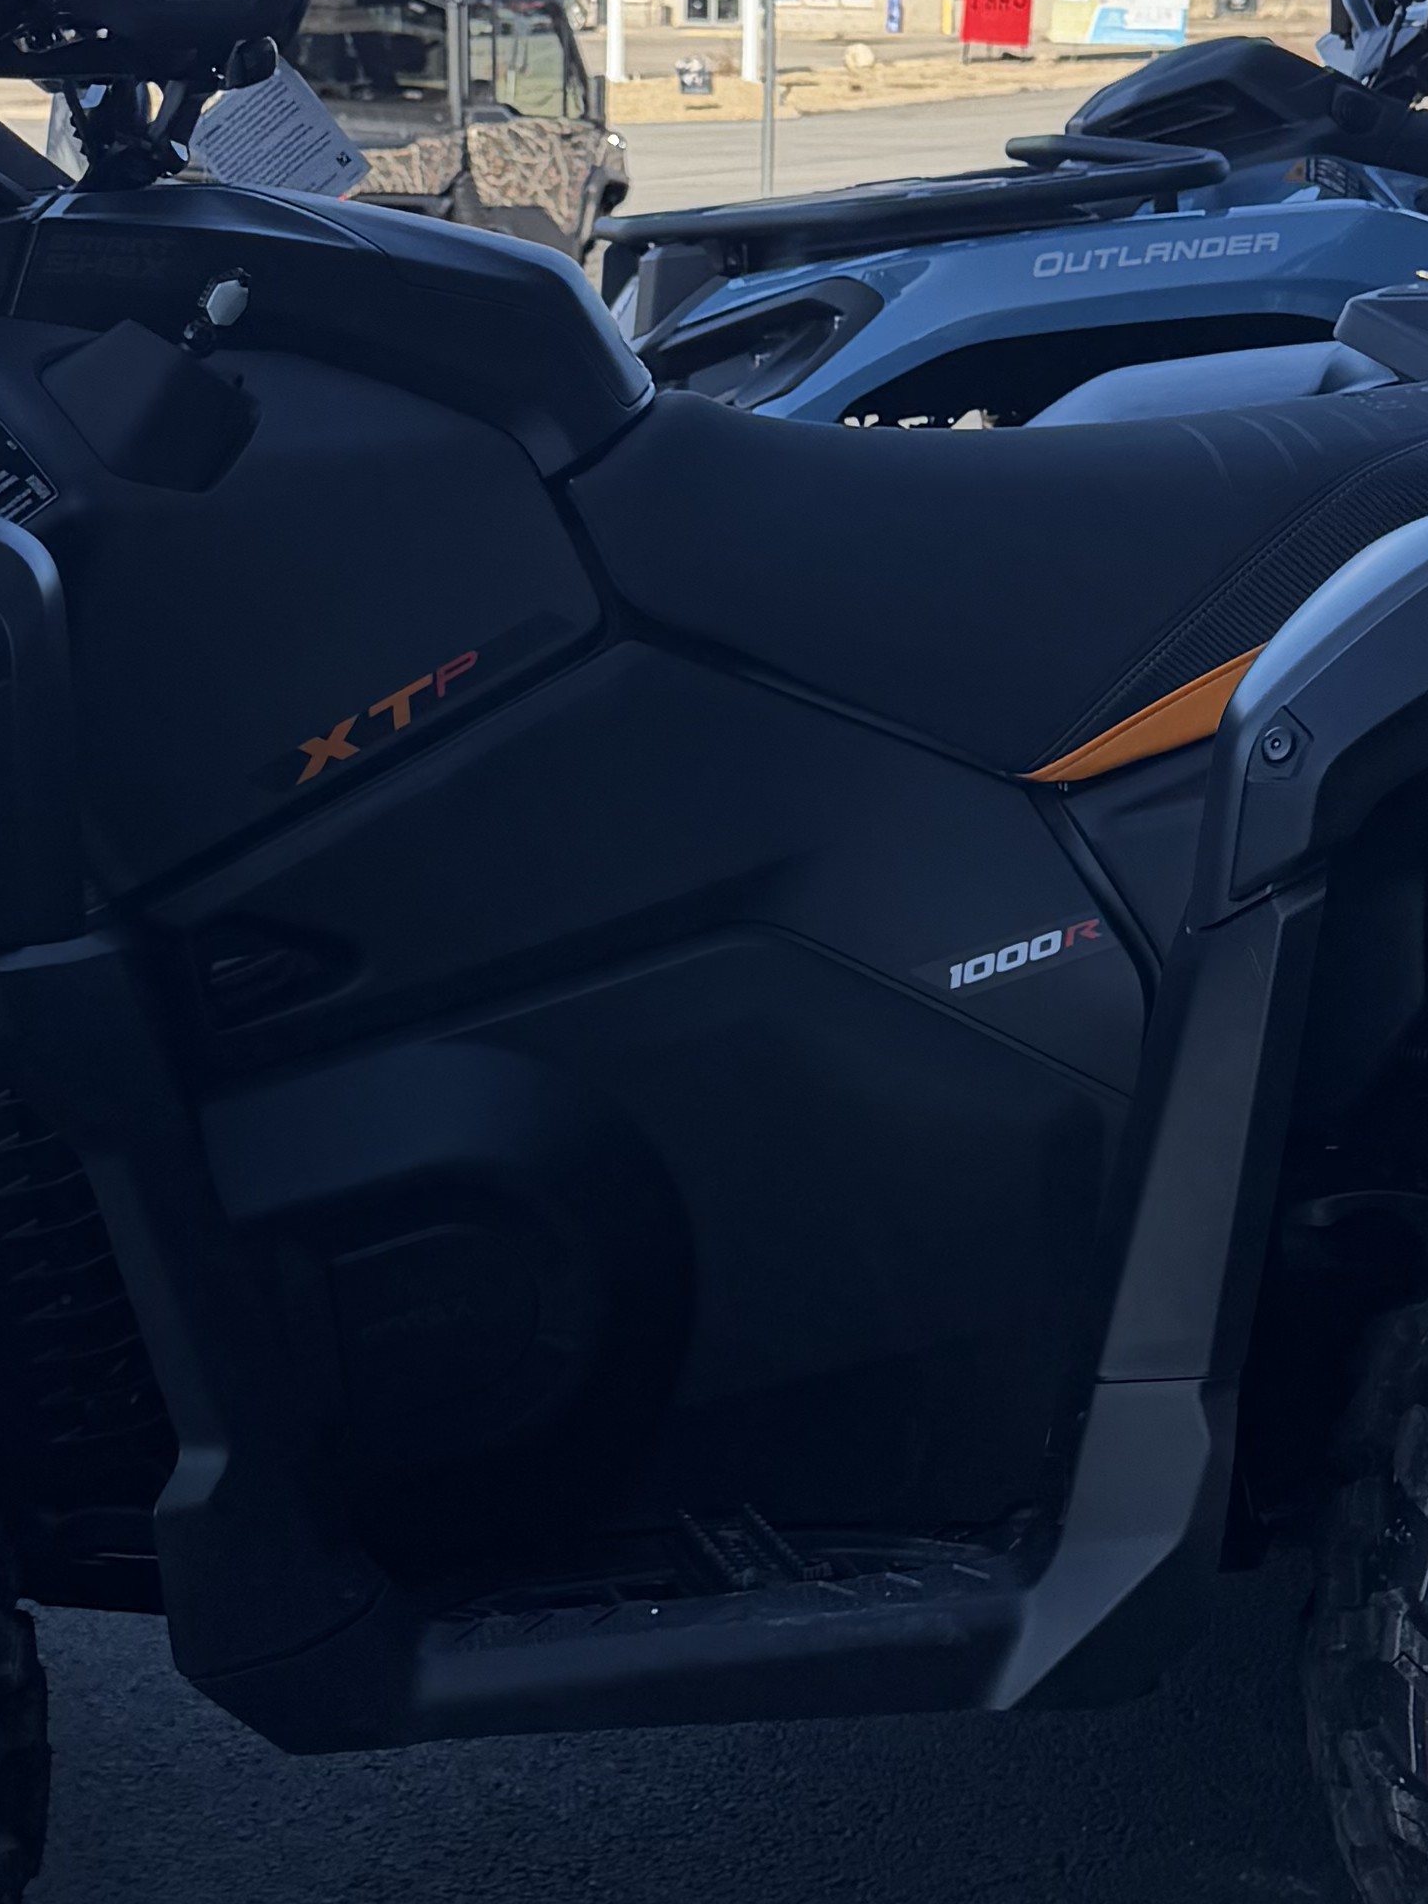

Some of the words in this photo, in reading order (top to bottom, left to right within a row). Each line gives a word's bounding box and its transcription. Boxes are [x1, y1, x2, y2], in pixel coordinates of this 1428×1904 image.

[1033, 232, 1281, 278] OUTLANDER
[295, 650, 478, 786] XTP
[948, 918, 1104, 990] 1000R
